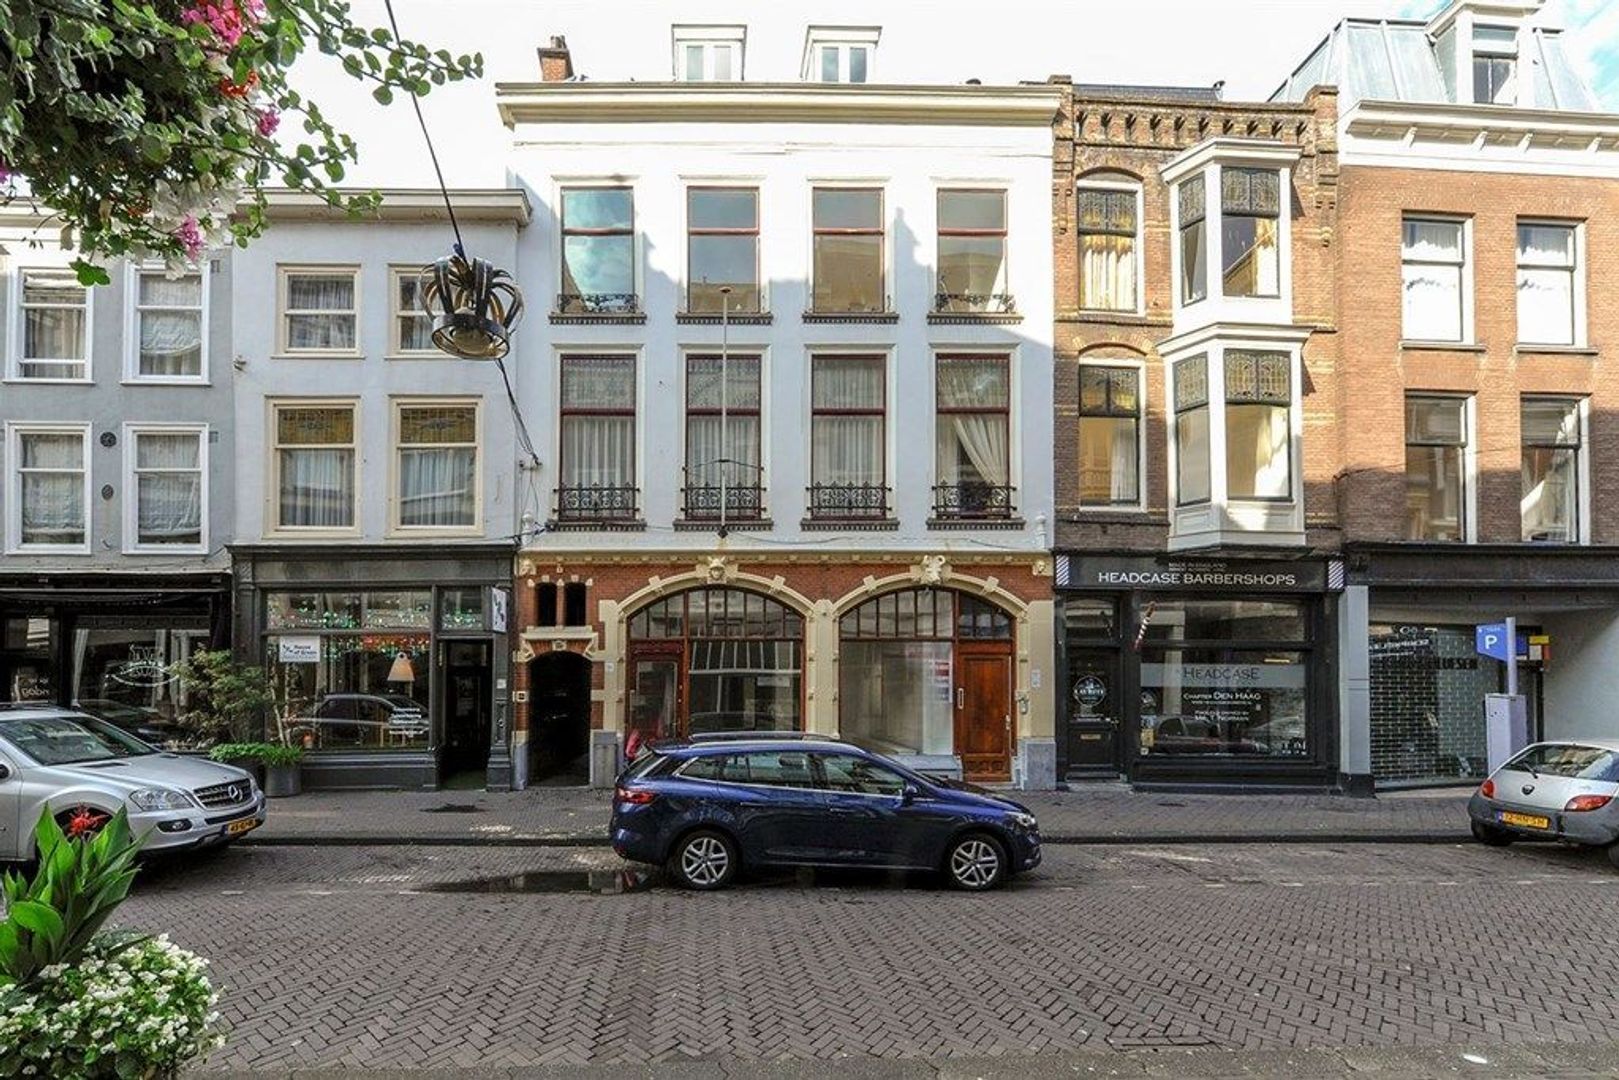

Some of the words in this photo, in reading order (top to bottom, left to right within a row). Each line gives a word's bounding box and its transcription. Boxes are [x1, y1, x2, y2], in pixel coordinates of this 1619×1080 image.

[1098, 572, 1181, 584] HEADCASE
[1183, 573, 1296, 586] BARBERSHOPS
[1485, 635, 1497, 649] P
[1183, 667, 1260, 680] HEADCASE
